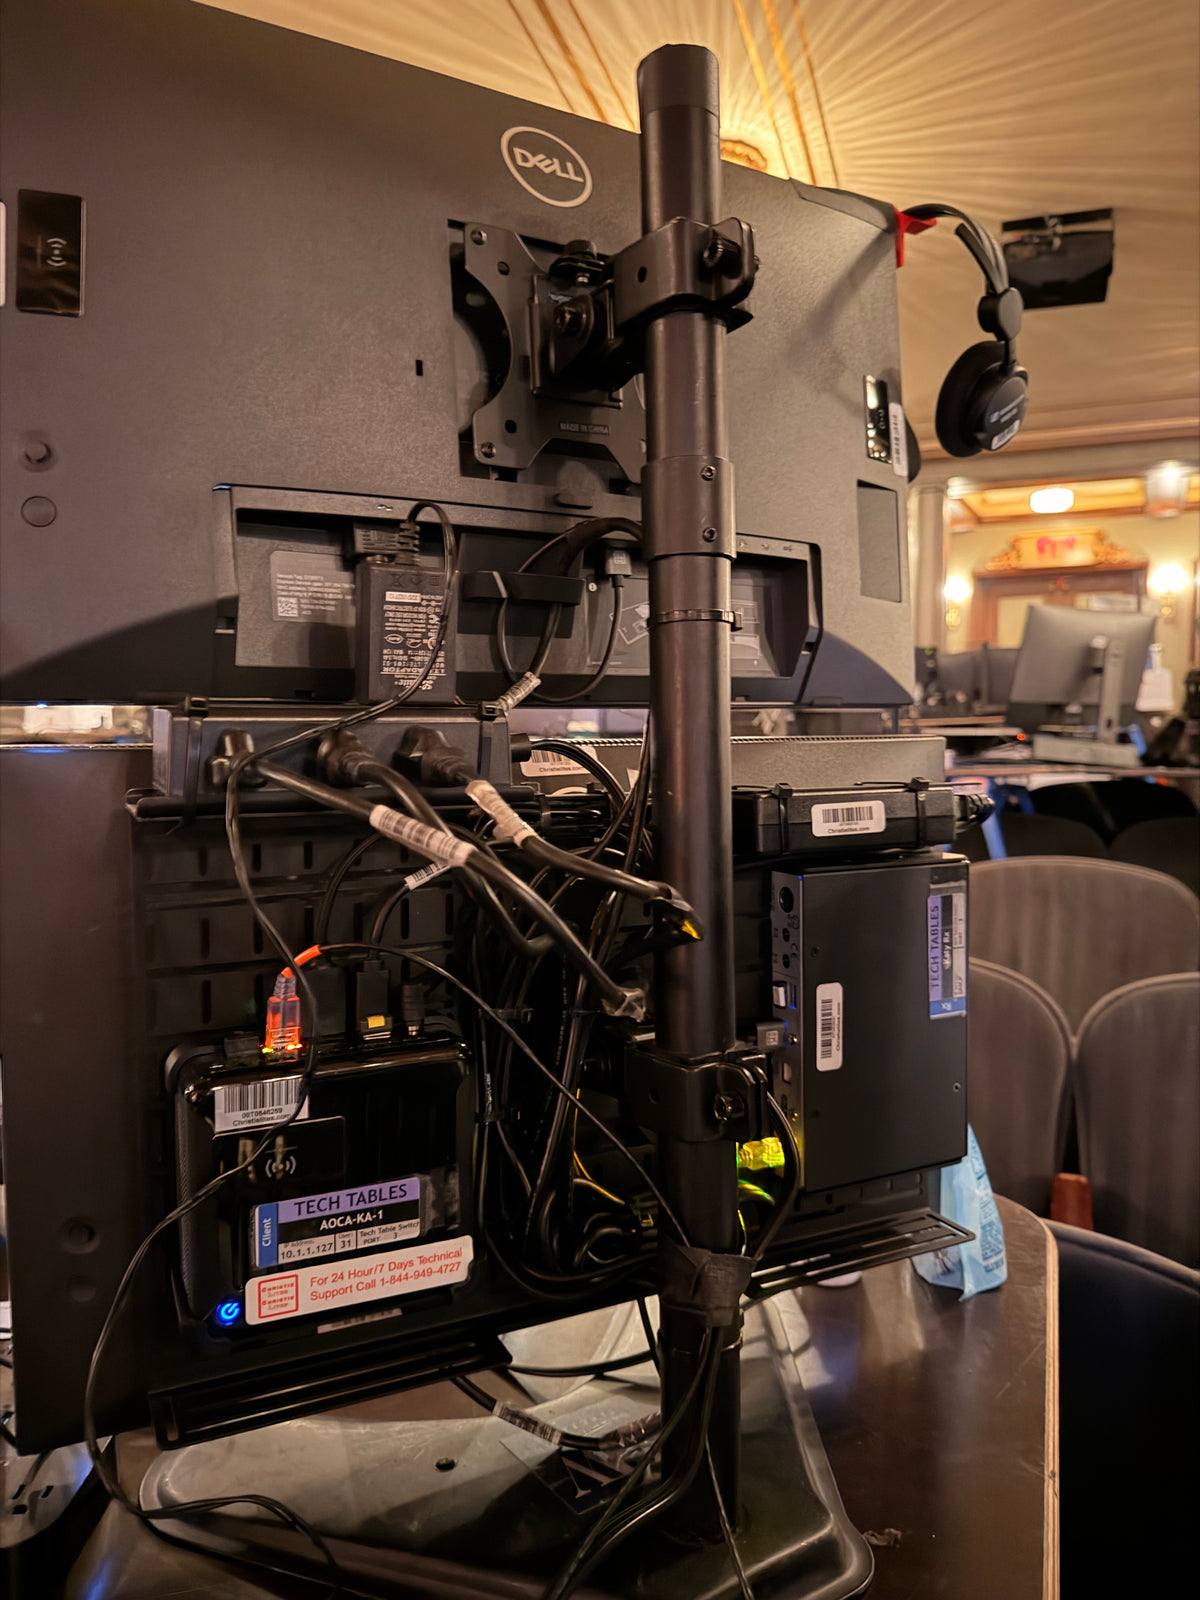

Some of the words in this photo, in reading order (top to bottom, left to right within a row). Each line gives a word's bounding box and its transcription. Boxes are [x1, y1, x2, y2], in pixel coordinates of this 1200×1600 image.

[512, 146, 584, 184] DELL
[929, 905, 940, 953] TABLES
[929, 955, 940, 989] TECH
[941, 1002, 952, 1011] Rx
[294, 1195, 340, 1216] TECH
[346, 1183, 408, 1207] TABLES
[262, 1217, 272, 1247] Client
[319, 1209, 384, 1231] AOCA-KA-1
[360, 1229, 376, 1238] Tech
[378, 1225, 397, 1234] Table
[281, 1242, 333, 1260] 10.1.1.127
[340, 1239, 352, 1249] 31
[310, 1276, 328, 1287] For
[331, 1272, 345, 1284] 24
[348, 1263, 386, 1280] Hour/7
[388, 1258, 414, 1274] Days
[416, 1248, 462, 1266] Technical
[310, 1283, 353, 1302] Support
[356, 1278, 376, 1292] Call
[380, 1262, 461, 1287] 1-844-949-4727
